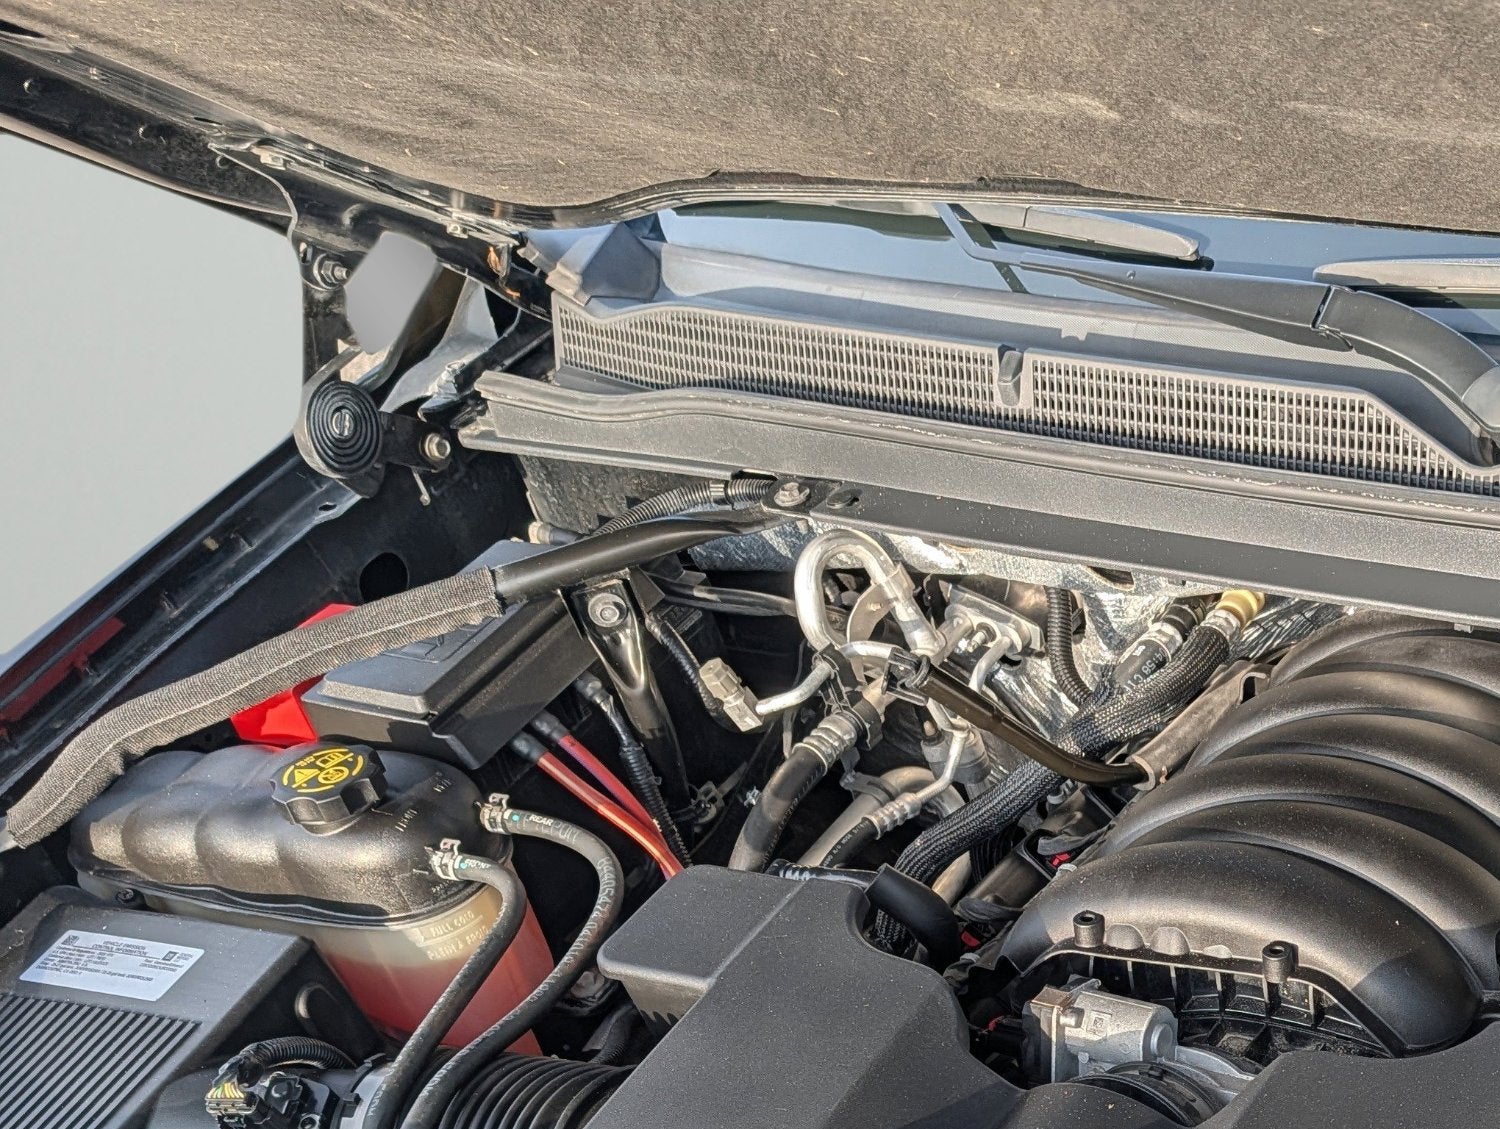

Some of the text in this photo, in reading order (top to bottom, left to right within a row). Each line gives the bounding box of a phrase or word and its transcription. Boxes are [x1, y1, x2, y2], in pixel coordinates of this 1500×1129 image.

[529, 814, 554, 826] REAR
[430, 910, 474, 937] FULL COLD
